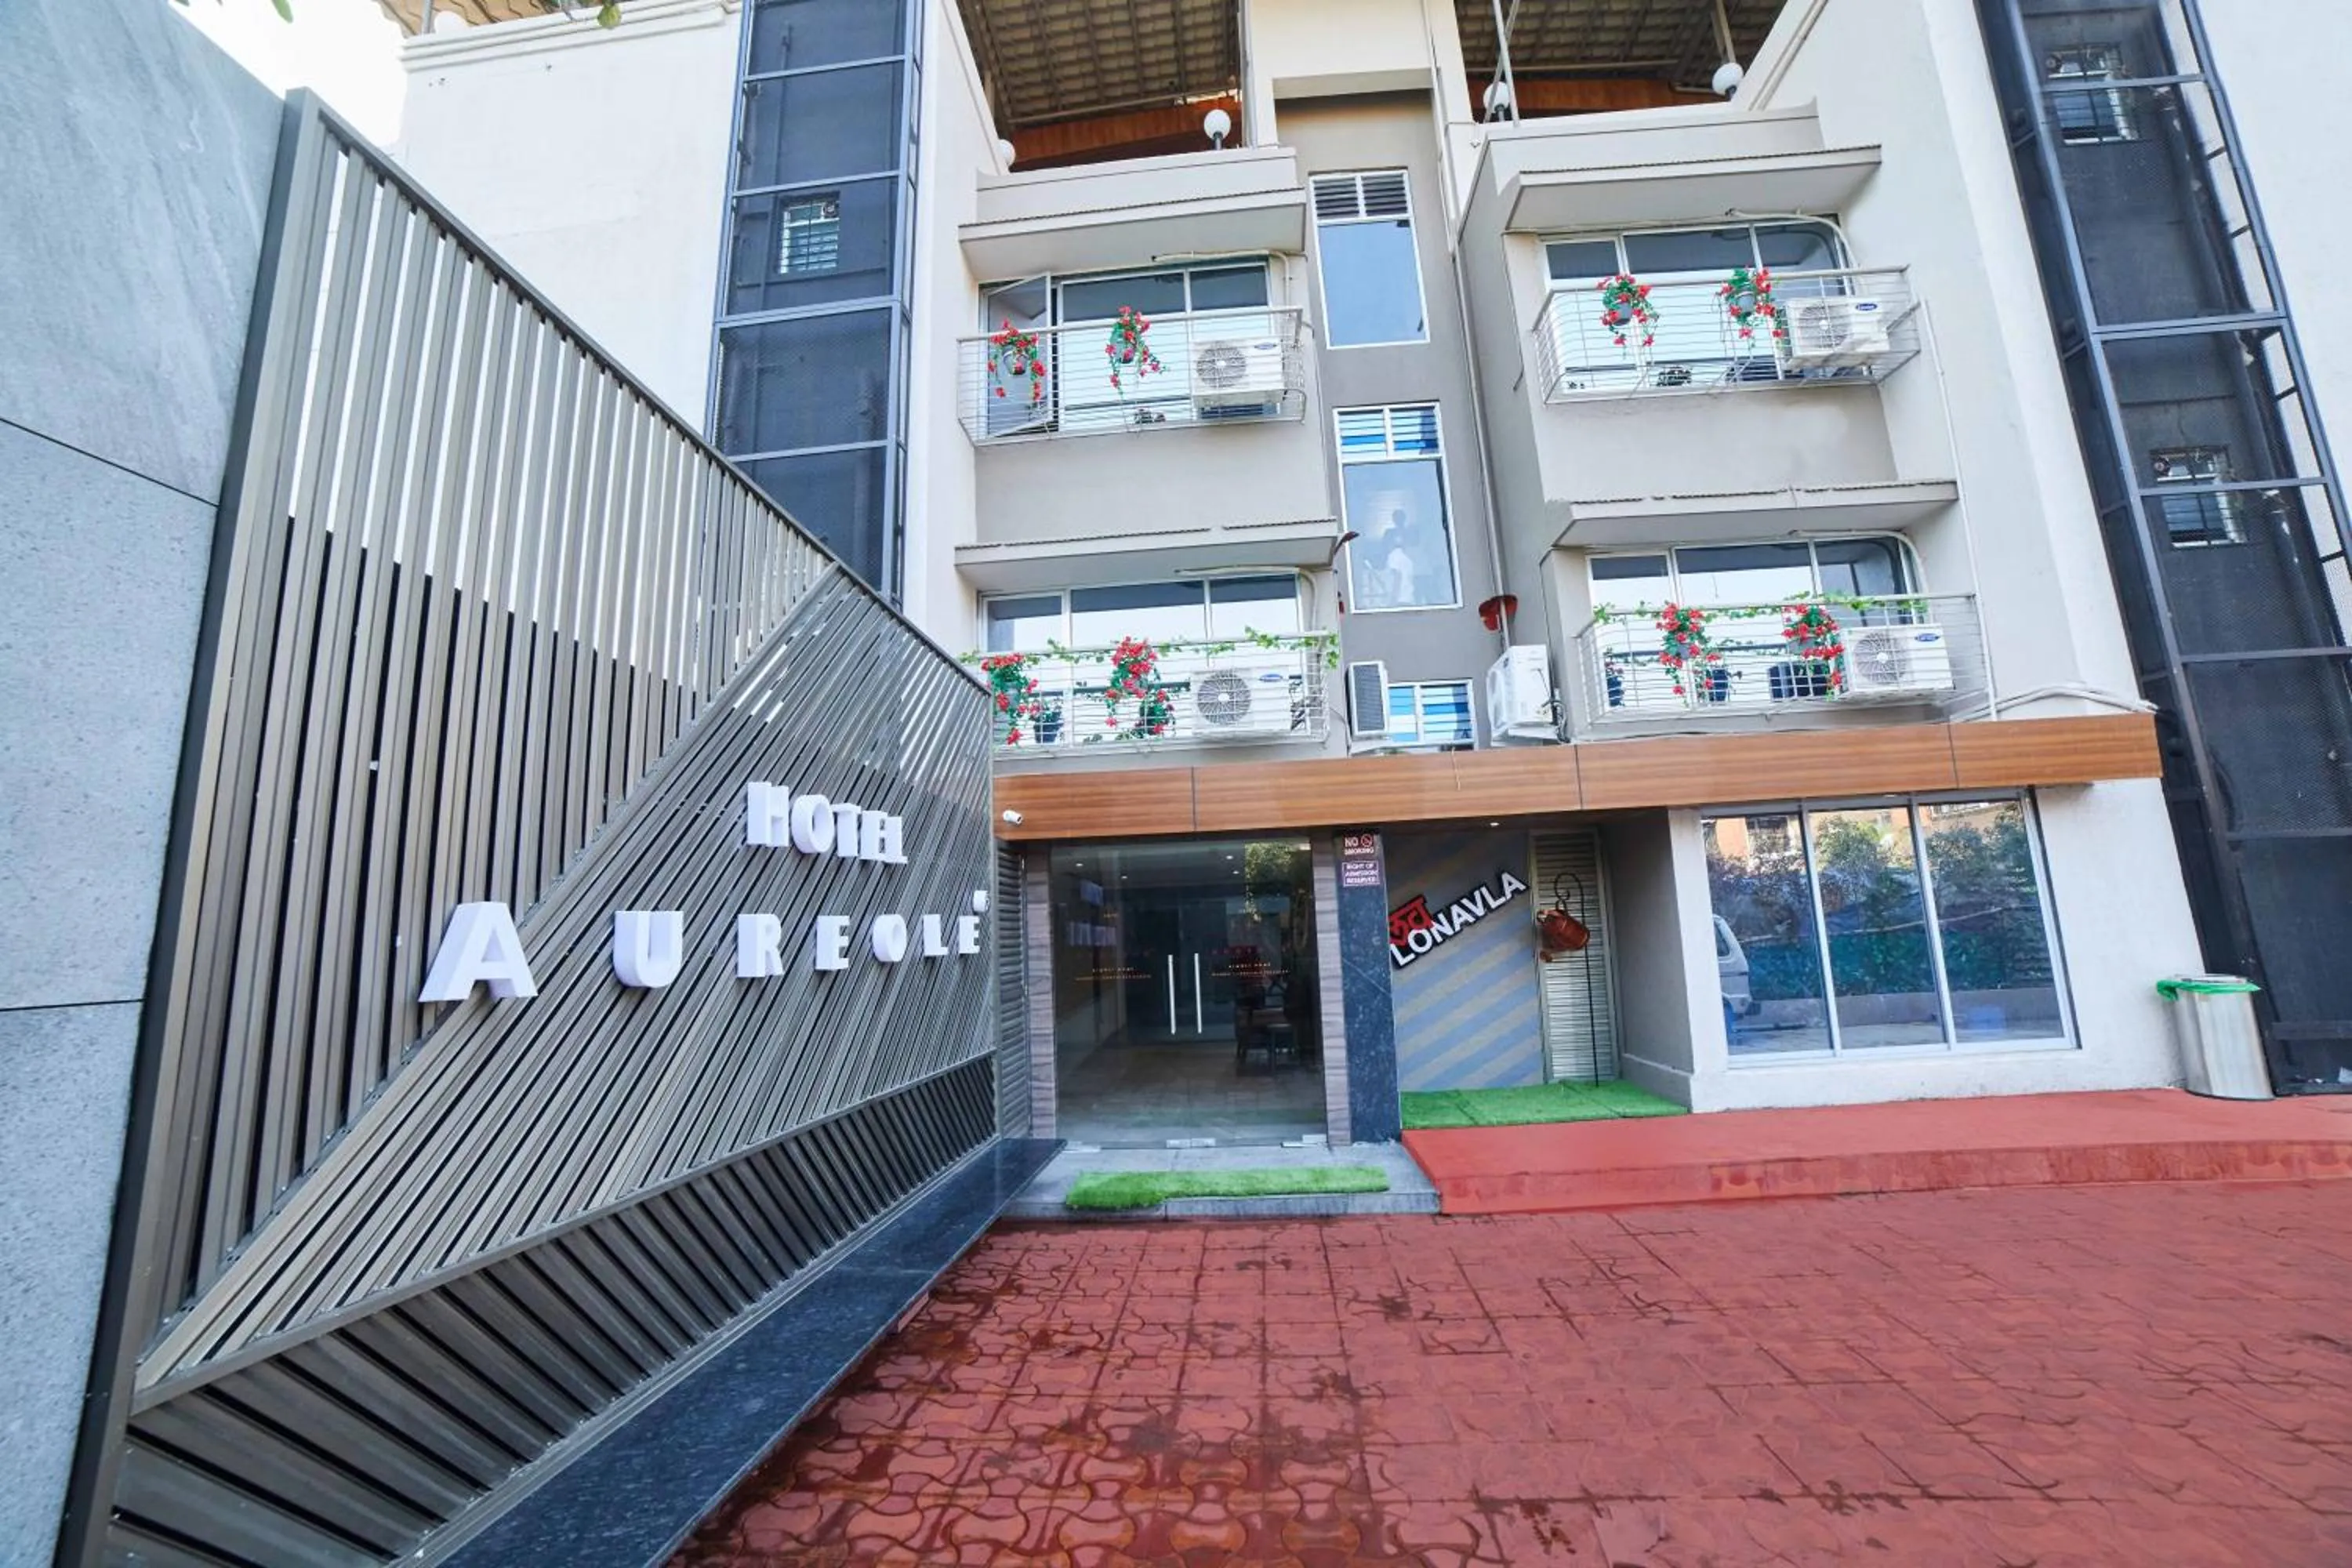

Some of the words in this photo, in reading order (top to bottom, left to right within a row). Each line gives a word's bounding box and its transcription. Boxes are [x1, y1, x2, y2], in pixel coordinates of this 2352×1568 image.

[746, 782, 908, 865] HOTEL
[1344, 836, 1359, 848] NO
[418, 902, 980, 1004] AUREOLE
[1389, 872, 1526, 967] LONAVLA
